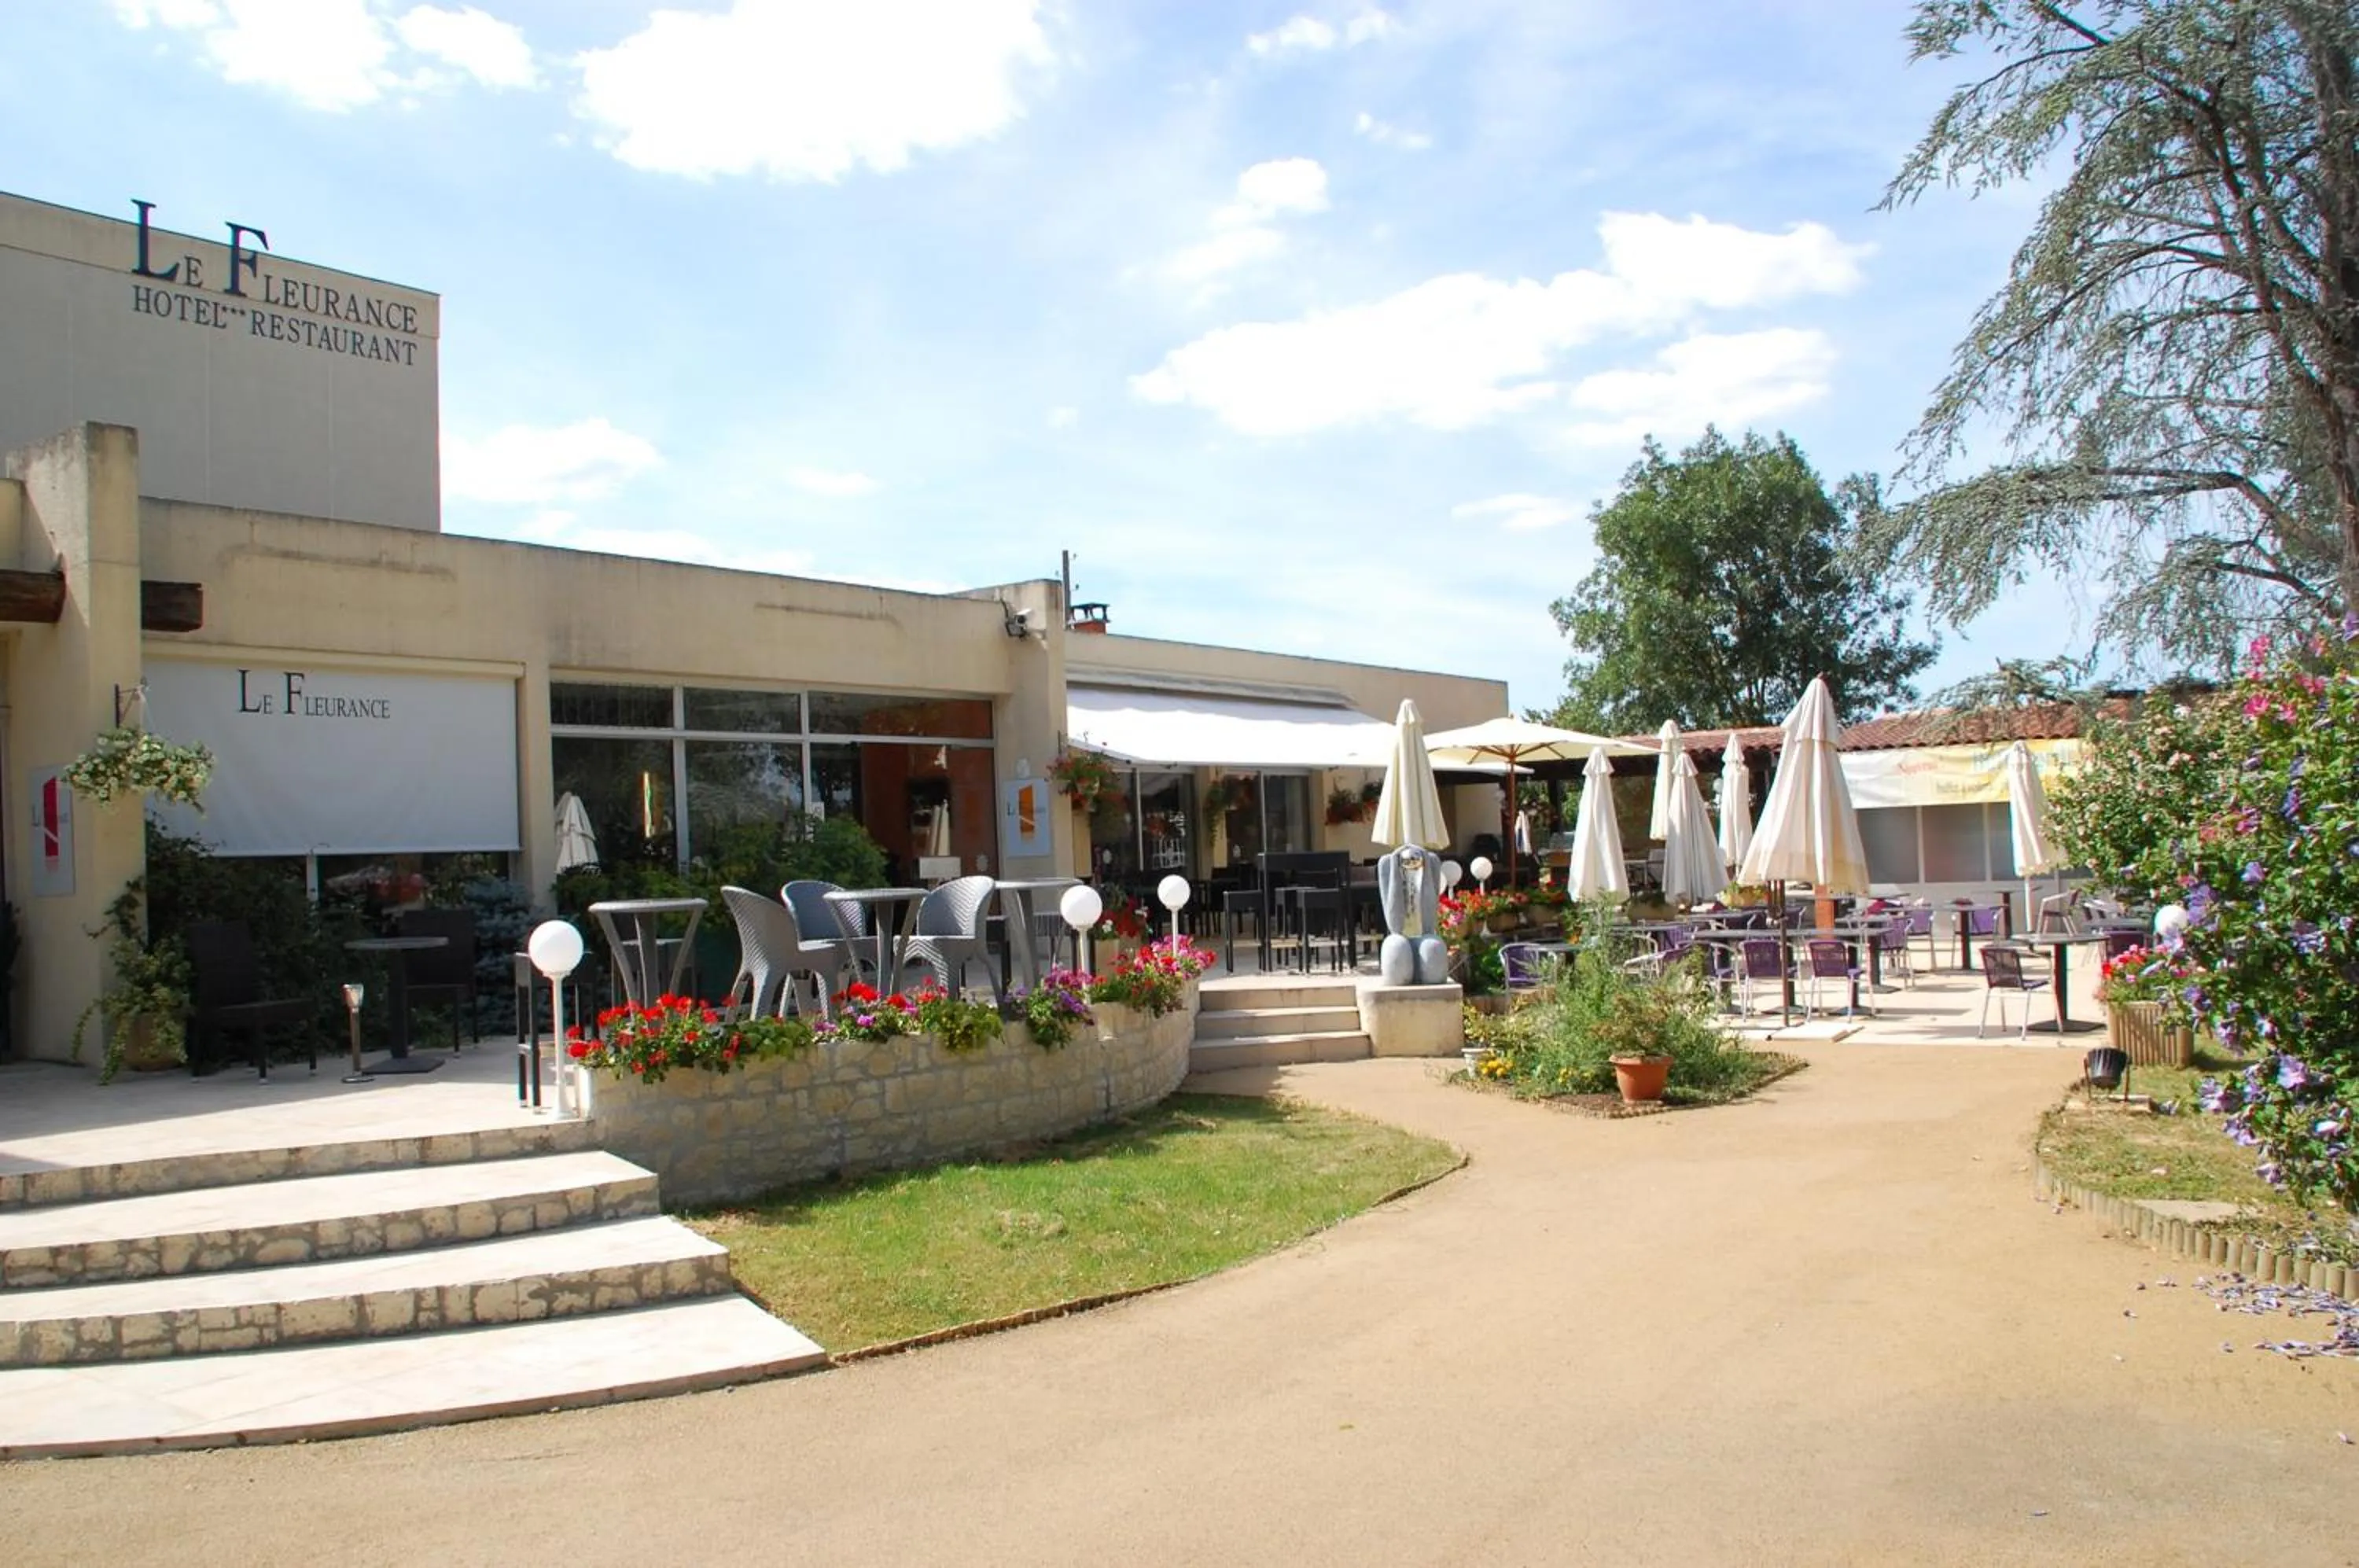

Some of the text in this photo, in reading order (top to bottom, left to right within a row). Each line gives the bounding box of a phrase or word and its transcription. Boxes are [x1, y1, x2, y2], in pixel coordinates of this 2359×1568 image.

[131, 198, 418, 334] LE FLEURANCE
[251, 309, 418, 366] RESTAURANT
[238, 668, 391, 719] LE FLEURANCE
